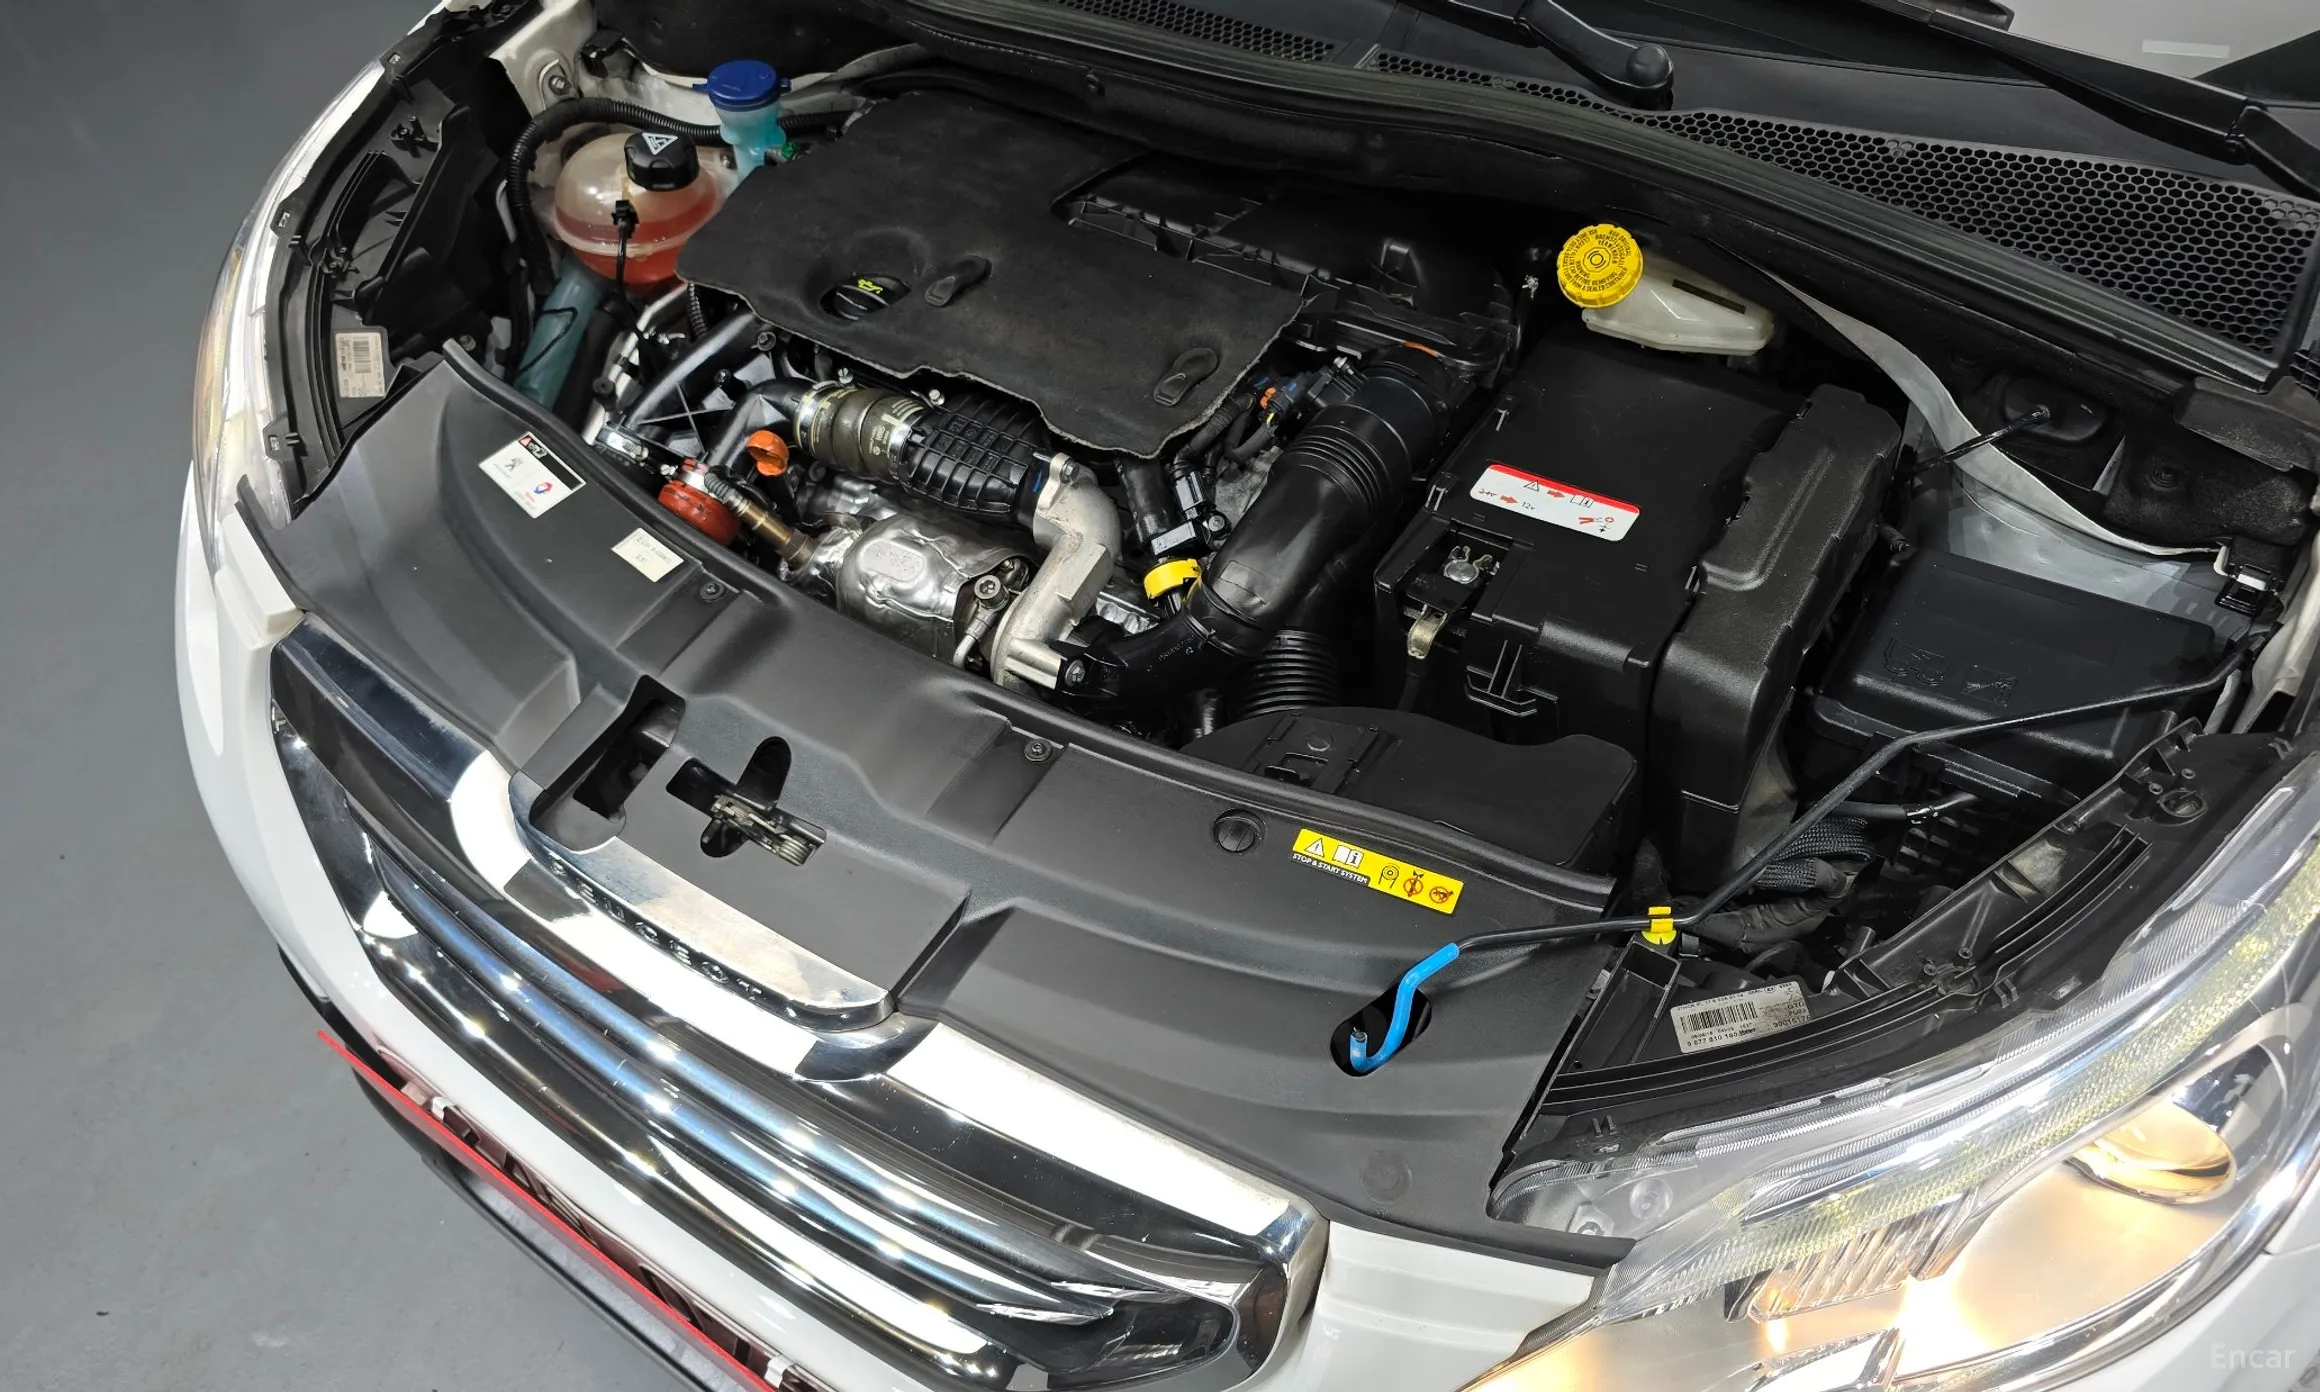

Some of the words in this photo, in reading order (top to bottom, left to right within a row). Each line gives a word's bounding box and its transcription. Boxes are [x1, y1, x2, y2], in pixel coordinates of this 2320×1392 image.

[1292, 853, 1312, 864] STOP
[1318, 862, 1340, 875] START
[1341, 870, 1368, 884] SYSTEM
